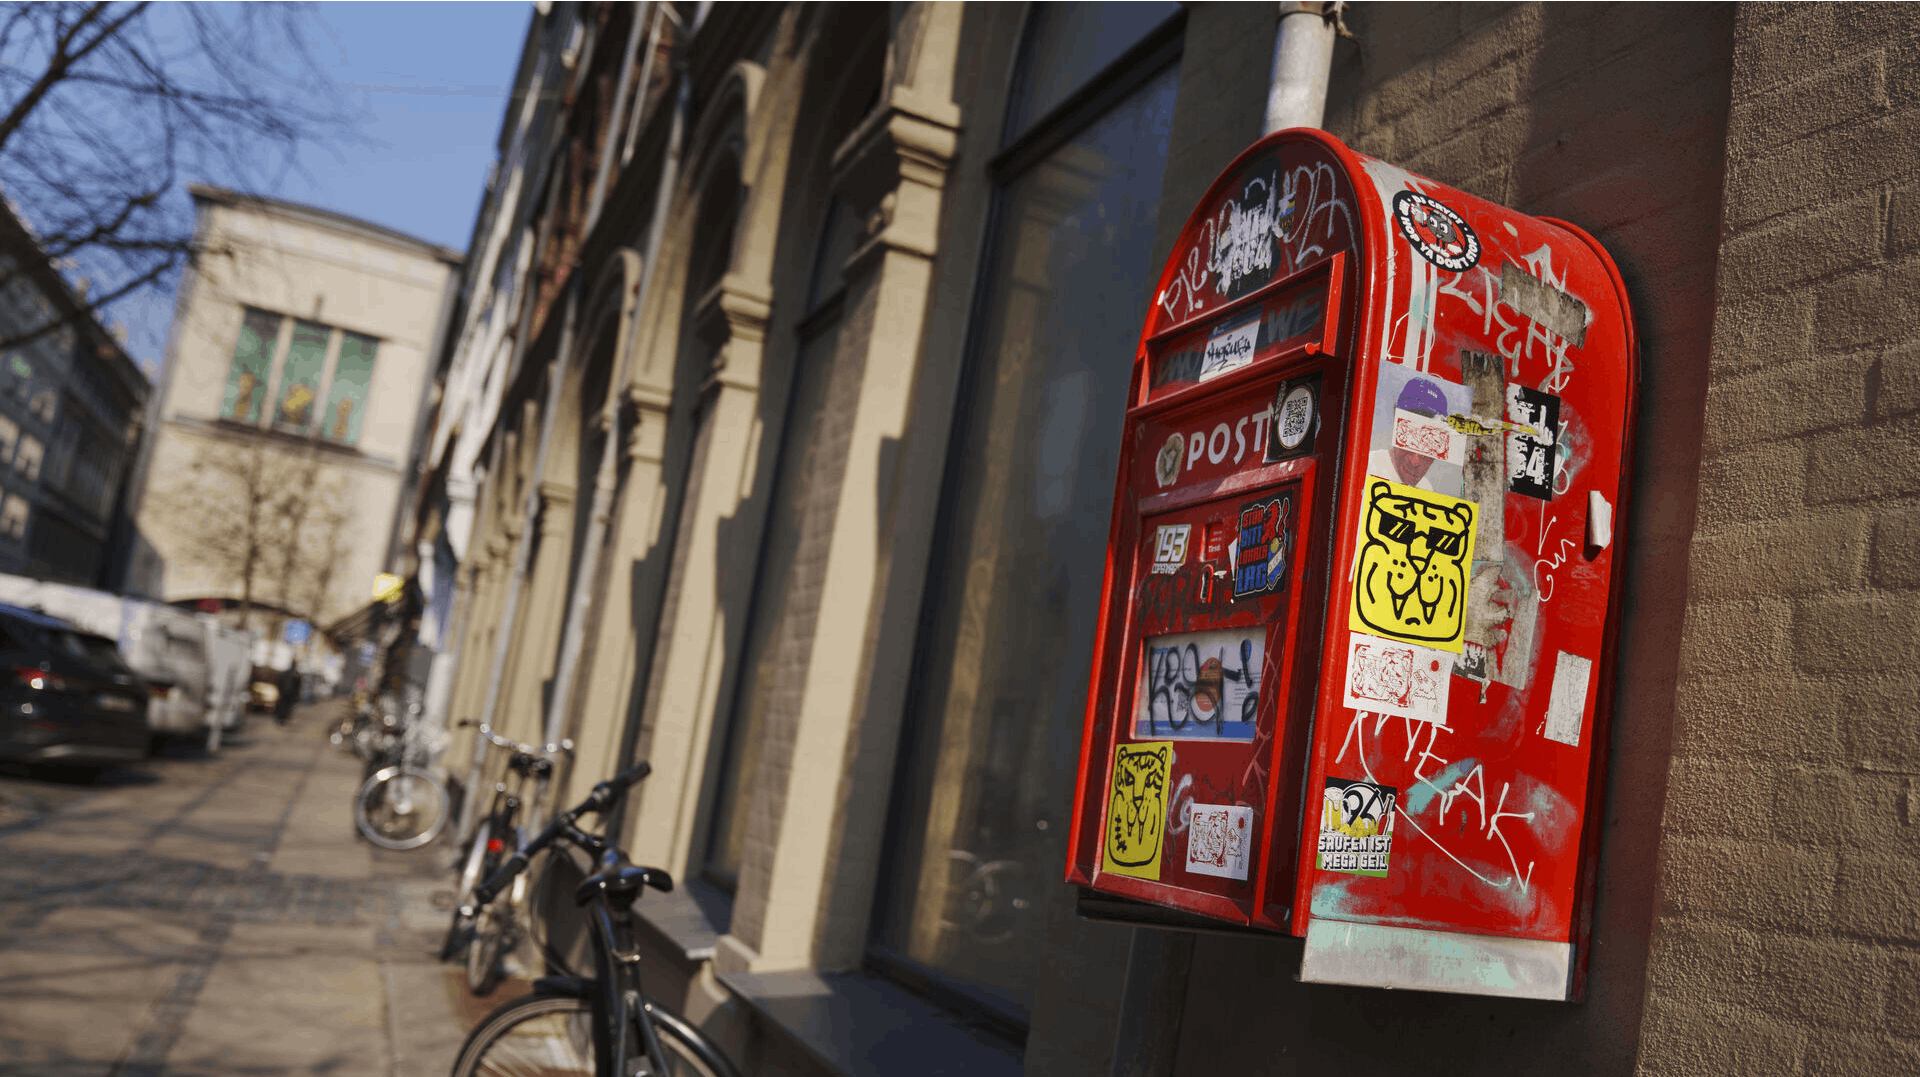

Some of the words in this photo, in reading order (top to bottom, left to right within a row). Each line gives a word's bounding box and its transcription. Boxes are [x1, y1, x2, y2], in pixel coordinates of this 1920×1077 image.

[1400, 216, 1420, 242] HOP
[1420, 241, 1434, 260] YA
[1465, 233, 1479, 263] STOP
[1186, 408, 1272, 471] POST
[1155, 526, 1189, 563] 193
[1236, 562, 1268, 593] LAG
[1318, 835, 1369, 853] SAUFEN
[1369, 836, 1392, 853] IST
[1322, 853, 1359, 869] MEGA
[1360, 853, 1388, 870] GEIL
